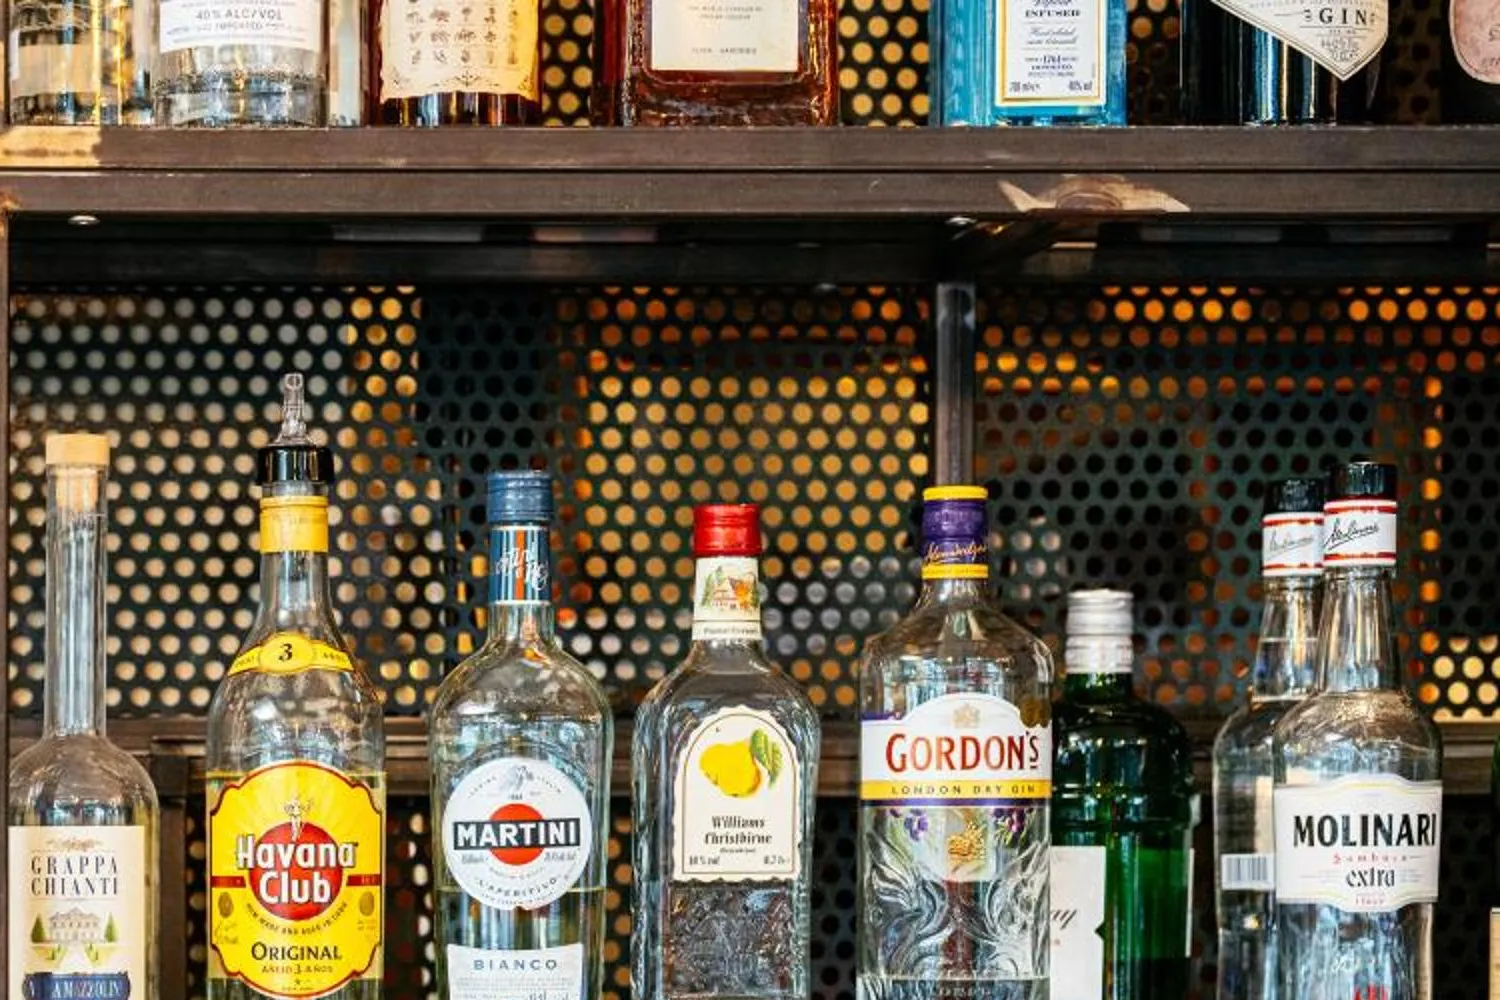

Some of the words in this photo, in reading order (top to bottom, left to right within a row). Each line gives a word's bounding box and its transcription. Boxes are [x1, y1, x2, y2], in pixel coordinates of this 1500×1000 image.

[1319, 8, 1367, 25] GIN
[278, 643, 293, 662] 3
[885, 731, 1040, 772] GORDON'S
[891, 786, 961, 794] LONDON
[973, 786, 1003, 794] DRY
[1011, 785, 1036, 794] GIN
[457, 821, 575, 847] MARTINI
[1293, 813, 1437, 847] MOLINARI
[236, 833, 357, 870] Havana
[31, 856, 118, 876] GRAPPA
[31, 877, 118, 897] CHIANTI
[258, 870, 332, 905] Club
[1346, 867, 1395, 888] extra
[251, 941, 343, 961] ORIGINAL
[474, 959, 557, 971] BIANCO
